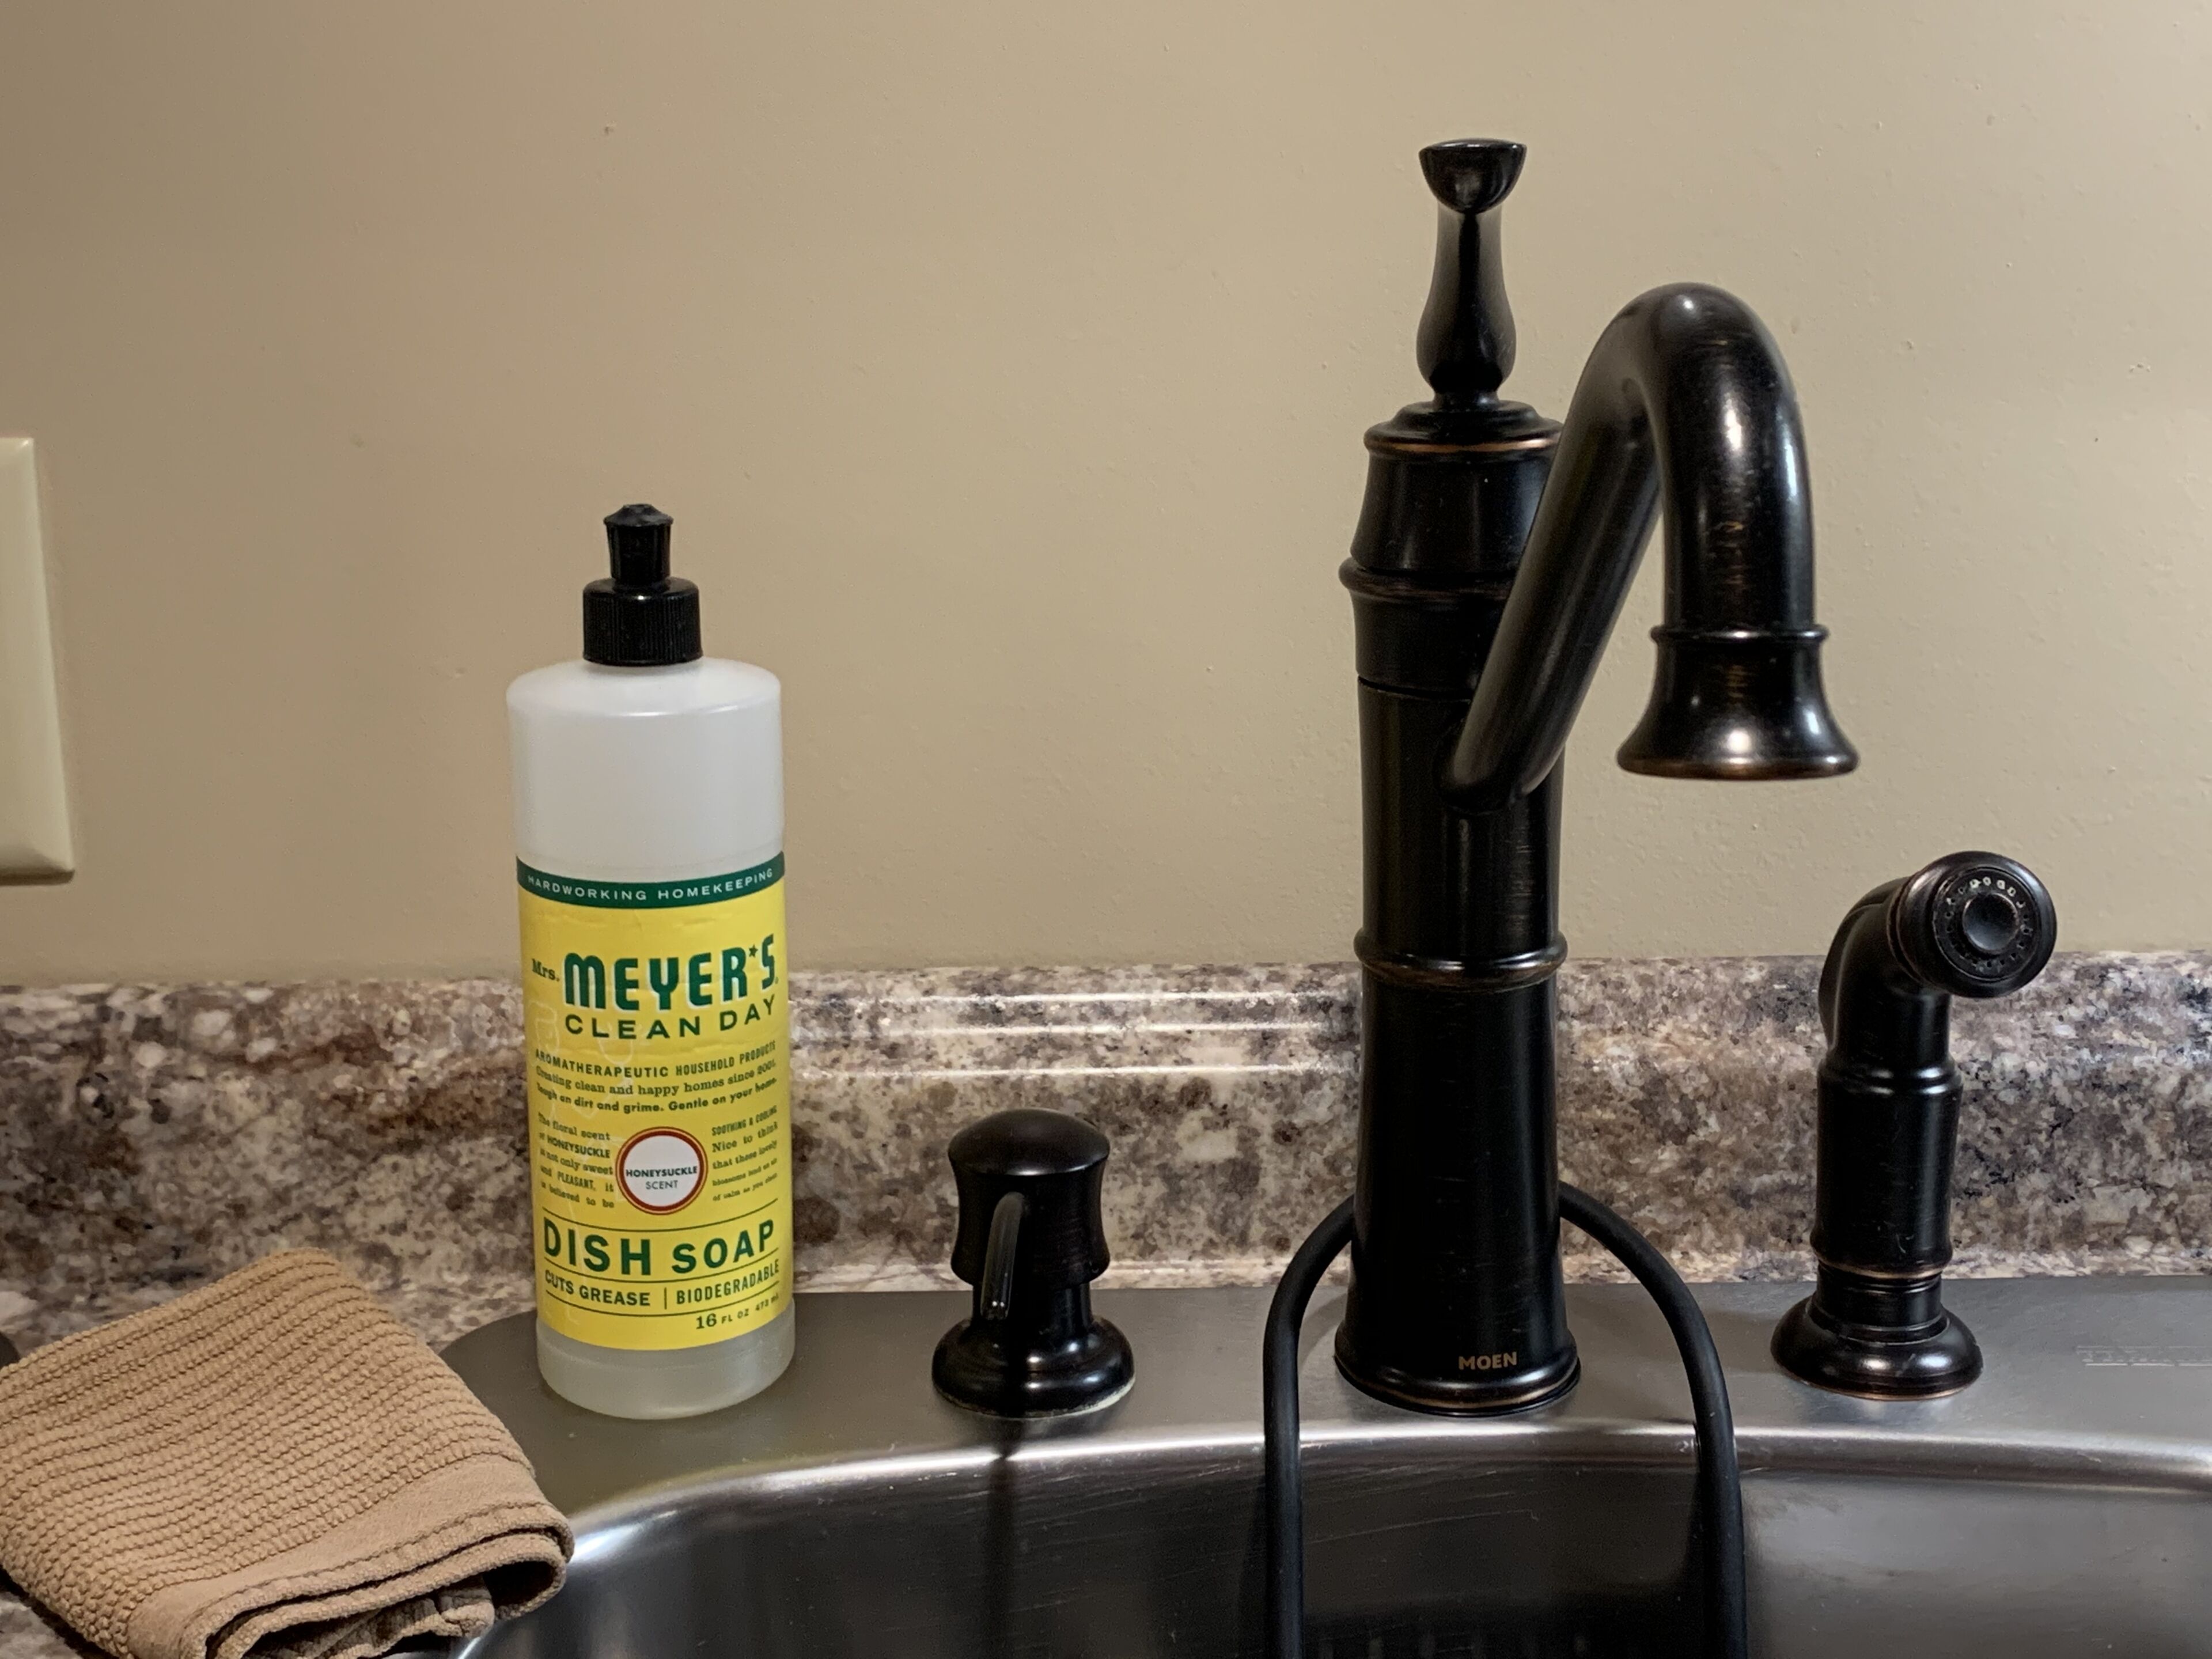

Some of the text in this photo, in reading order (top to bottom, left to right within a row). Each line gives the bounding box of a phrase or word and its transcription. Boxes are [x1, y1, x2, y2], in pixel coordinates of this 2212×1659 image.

[528, 868, 773, 900] HARDWORKING HOMEKEEPING
[532, 958, 560, 982] Mrs.
[565, 994, 775, 1039] CLEAN DAY
[535, 1040, 776, 1078] AROMATHERAPEUTIC HOUSEHOLD PRODUCTS
[536, 1065, 572, 1090] Creating
[575, 1080, 606, 1093] clean
[609, 1085, 634, 1095] and
[638, 1085, 680, 1097] happy
[683, 1082, 725, 1093] homes
[728, 1070, 755, 1085] since
[574, 1096, 593, 1109] dirt
[597, 1101, 619, 1111] and
[623, 1101, 664, 1114] grime.
[668, 1097, 709, 1111] Gentle
[712, 1096, 726, 1105] on
[730, 1088, 753, 1104] your
[552, 1120, 578, 1136] floral
[581, 1130, 611, 1141] scent
[547, 1135, 611, 1159] HONEYSUCKLE
[711, 1140, 737, 1153] Nice
[743, 1135, 753, 1144] to
[560, 1157, 581, 1172] only
[582, 1164, 613, 1175] sweet
[626, 1165, 698, 1179] HONEYSUCKLE
[712, 1158, 733, 1169] that
[605, 1183, 614, 1192] it
[645, 1180, 678, 1190] SCENT
[586, 1196, 597, 1206] to
[602, 1198, 615, 1209] be
[544, 1217, 774, 1276] DISH SOAP
[544, 1259, 779, 1306] CUTS GREASE BIODEGRADABLE
[696, 1313, 717, 1330] 16
[721, 1314, 733, 1324] FL
[737, 1308, 749, 1319] OZ
[755, 1299, 769, 1311] 473
[1458, 1351, 1517, 1370] MOEN
